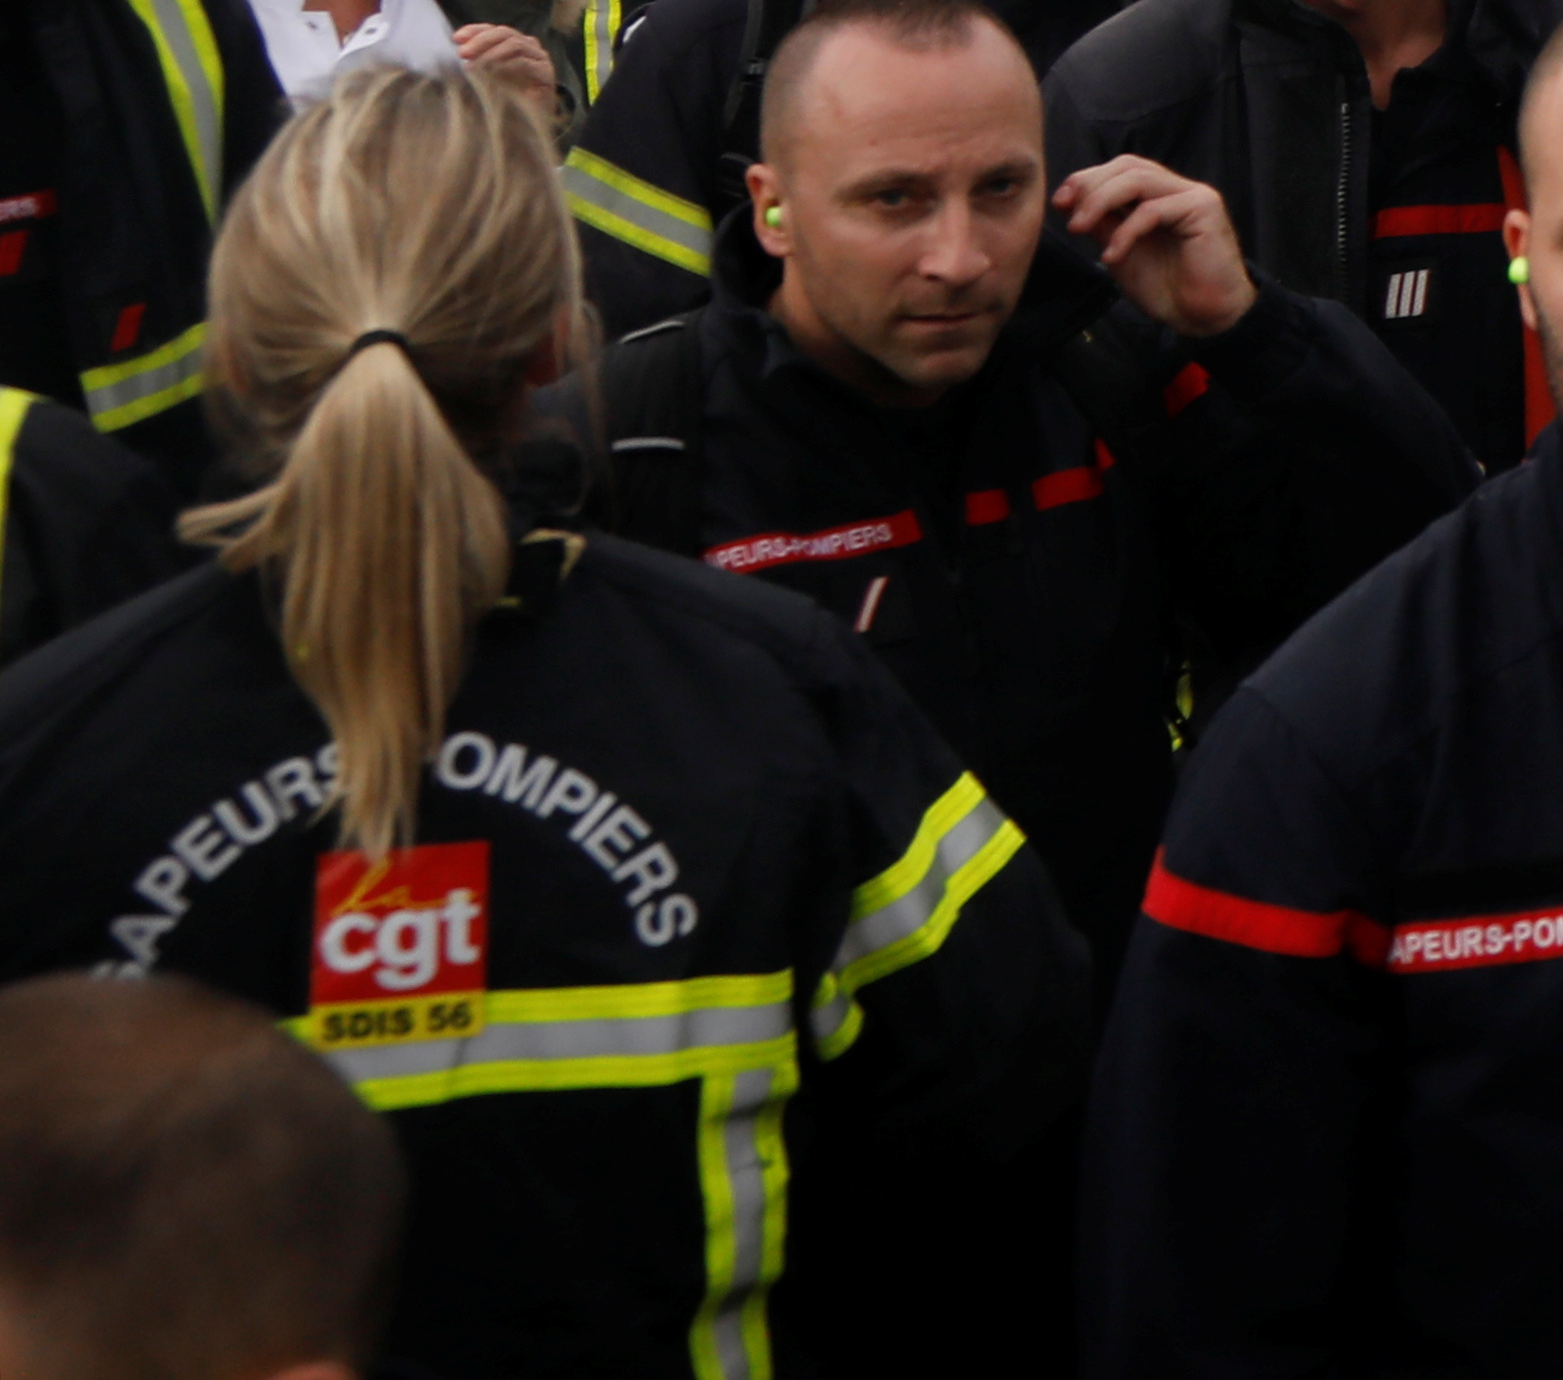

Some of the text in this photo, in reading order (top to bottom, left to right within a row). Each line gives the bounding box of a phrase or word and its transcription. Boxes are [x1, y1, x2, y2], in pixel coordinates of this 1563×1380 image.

[320, 887, 481, 991] cgt
[323, 1000, 474, 1041] SDIS 56
